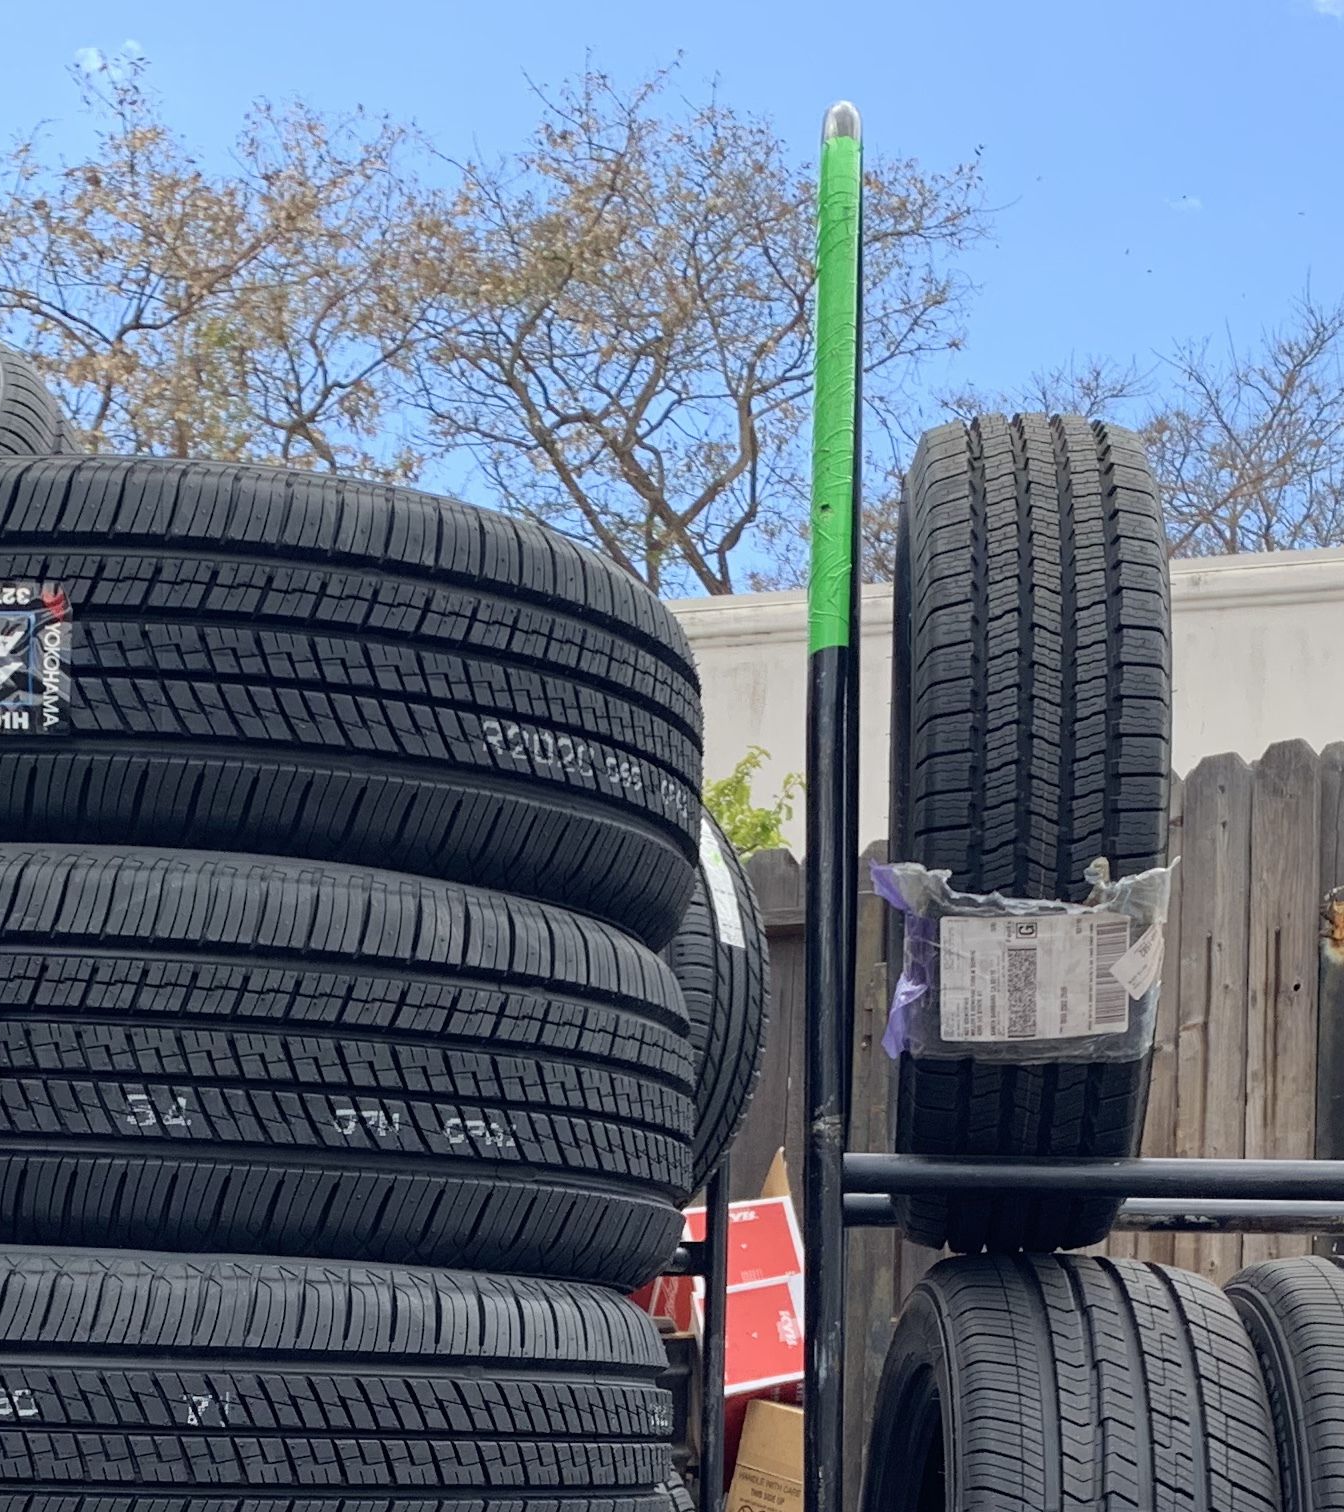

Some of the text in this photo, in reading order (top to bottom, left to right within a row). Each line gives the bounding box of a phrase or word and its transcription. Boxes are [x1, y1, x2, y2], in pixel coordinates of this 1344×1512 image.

[42, 621, 61, 726] YOKOHAMA
[1018, 924, 1035, 936] G
[765, 1479, 783, 1491] WITH
[783, 1485, 802, 1498] CARE
